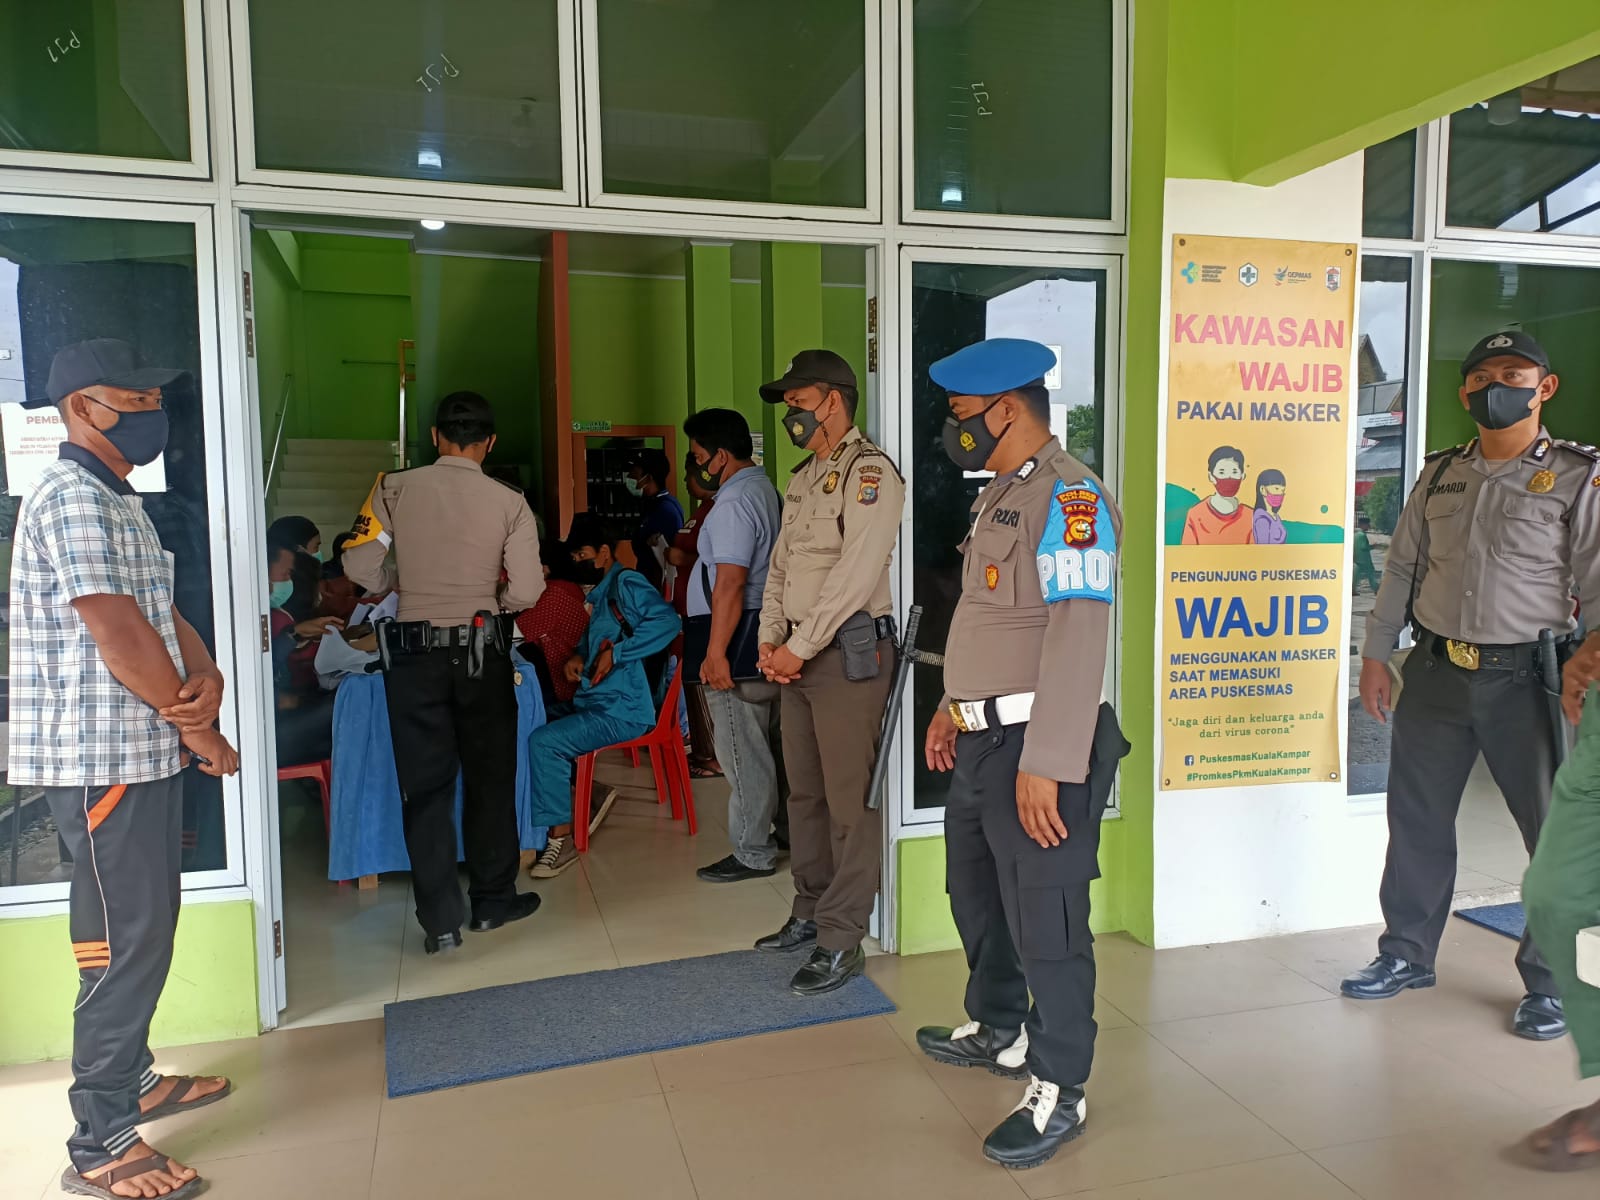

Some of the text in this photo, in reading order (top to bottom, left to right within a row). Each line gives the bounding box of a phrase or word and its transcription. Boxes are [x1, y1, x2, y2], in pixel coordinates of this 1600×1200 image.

[1174, 313, 1345, 349] KAWASAN
[1239, 362, 1343, 393] WAJIB
[1177, 401, 1341, 423] PAKAI MASKER
[1065, 504, 1096, 513] RIAU
[1037, 549, 1116, 599] PRO
[1171, 569, 1337, 583] PENGUNJUNG PUSKESMAS
[1175, 595, 1329, 639] WAJIB
[1170, 648, 1336, 666] MENGGUNAKAN MASKER
[1169, 667, 1281, 683] SAAT MEMASUKI
[1169, 684, 1294, 700] AREA PUSKESMAS
[1203, 715, 1221, 725] diri
[1225, 714, 1245, 724] dan
[1250, 712, 1295, 723] keluarga
[1299, 710, 1325, 720] anda
[1199, 728, 1221, 738] dari
[1225, 727, 1251, 737] virus
[1199, 750, 1311, 763] PuskesmasKualaKampar
[1187, 767, 1311, 782] #PromkesPkmKualaKampar
